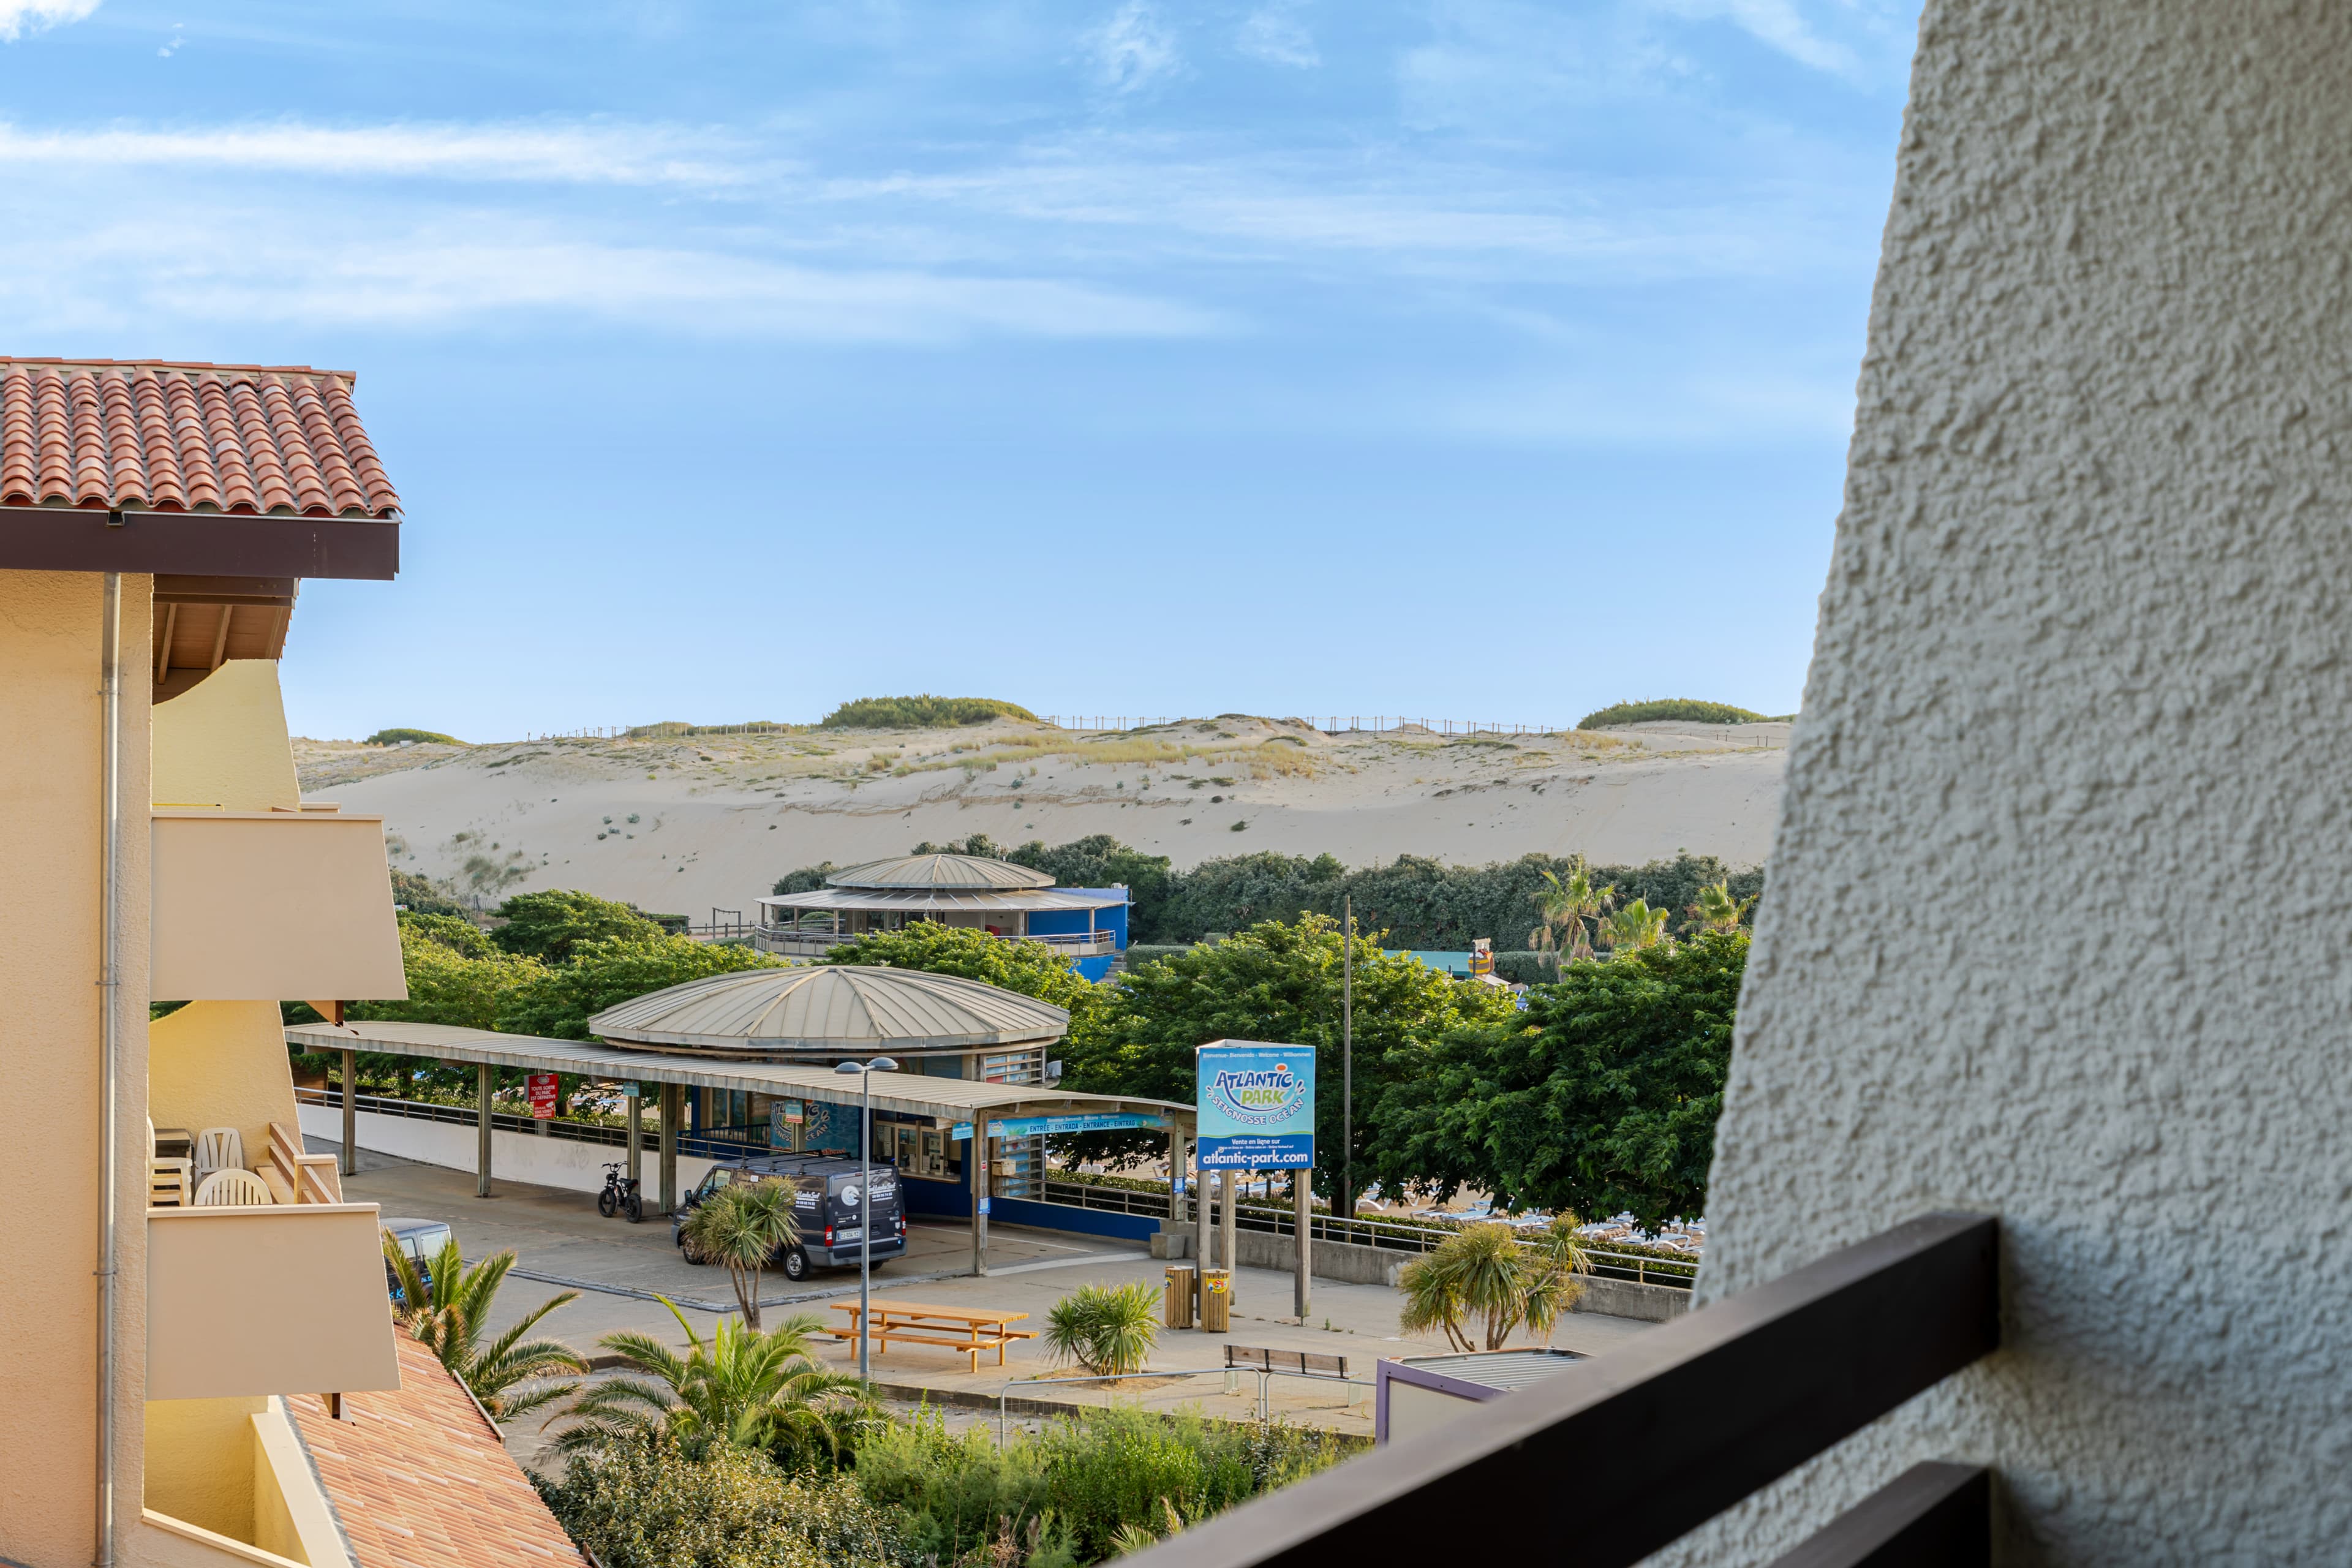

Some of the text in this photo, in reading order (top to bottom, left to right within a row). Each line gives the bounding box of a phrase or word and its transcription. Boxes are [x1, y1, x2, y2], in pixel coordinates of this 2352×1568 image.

[1215, 1070, 1293, 1089] ATLANTIC
[1241, 1089, 1288, 1105] PARK
[1212, 1096, 1305, 1125] SEIGNOSSE OCÉAN
[1030, 1123, 1050, 1132] ENTRÉE
[1055, 1122, 1079, 1131] ENTRADA
[1203, 1150, 1308, 1166] atlantic-park.com
